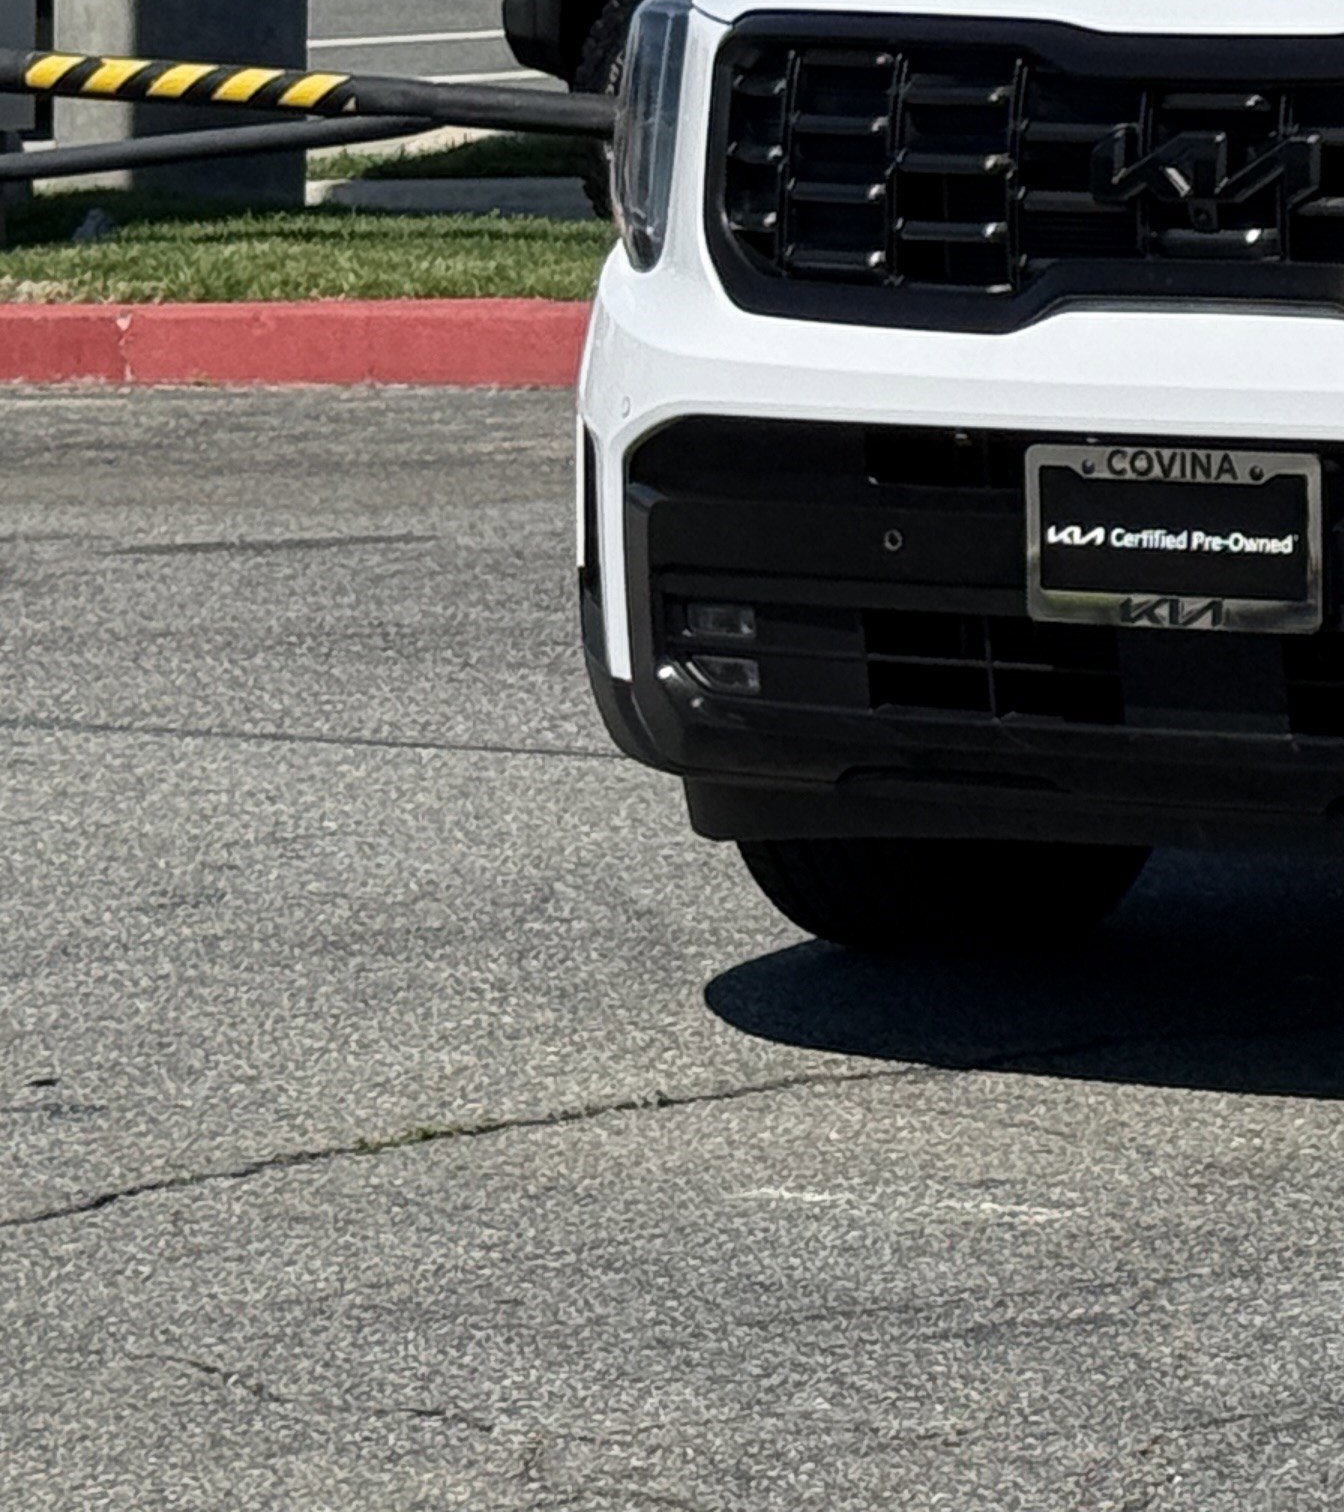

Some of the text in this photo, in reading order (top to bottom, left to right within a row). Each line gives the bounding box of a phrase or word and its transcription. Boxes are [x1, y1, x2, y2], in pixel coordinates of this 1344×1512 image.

[1106, 449, 1239, 481] COVINA
[1047, 525, 1294, 555] KIA Certified Pre-Owned
[1119, 597, 1224, 628] KIA
